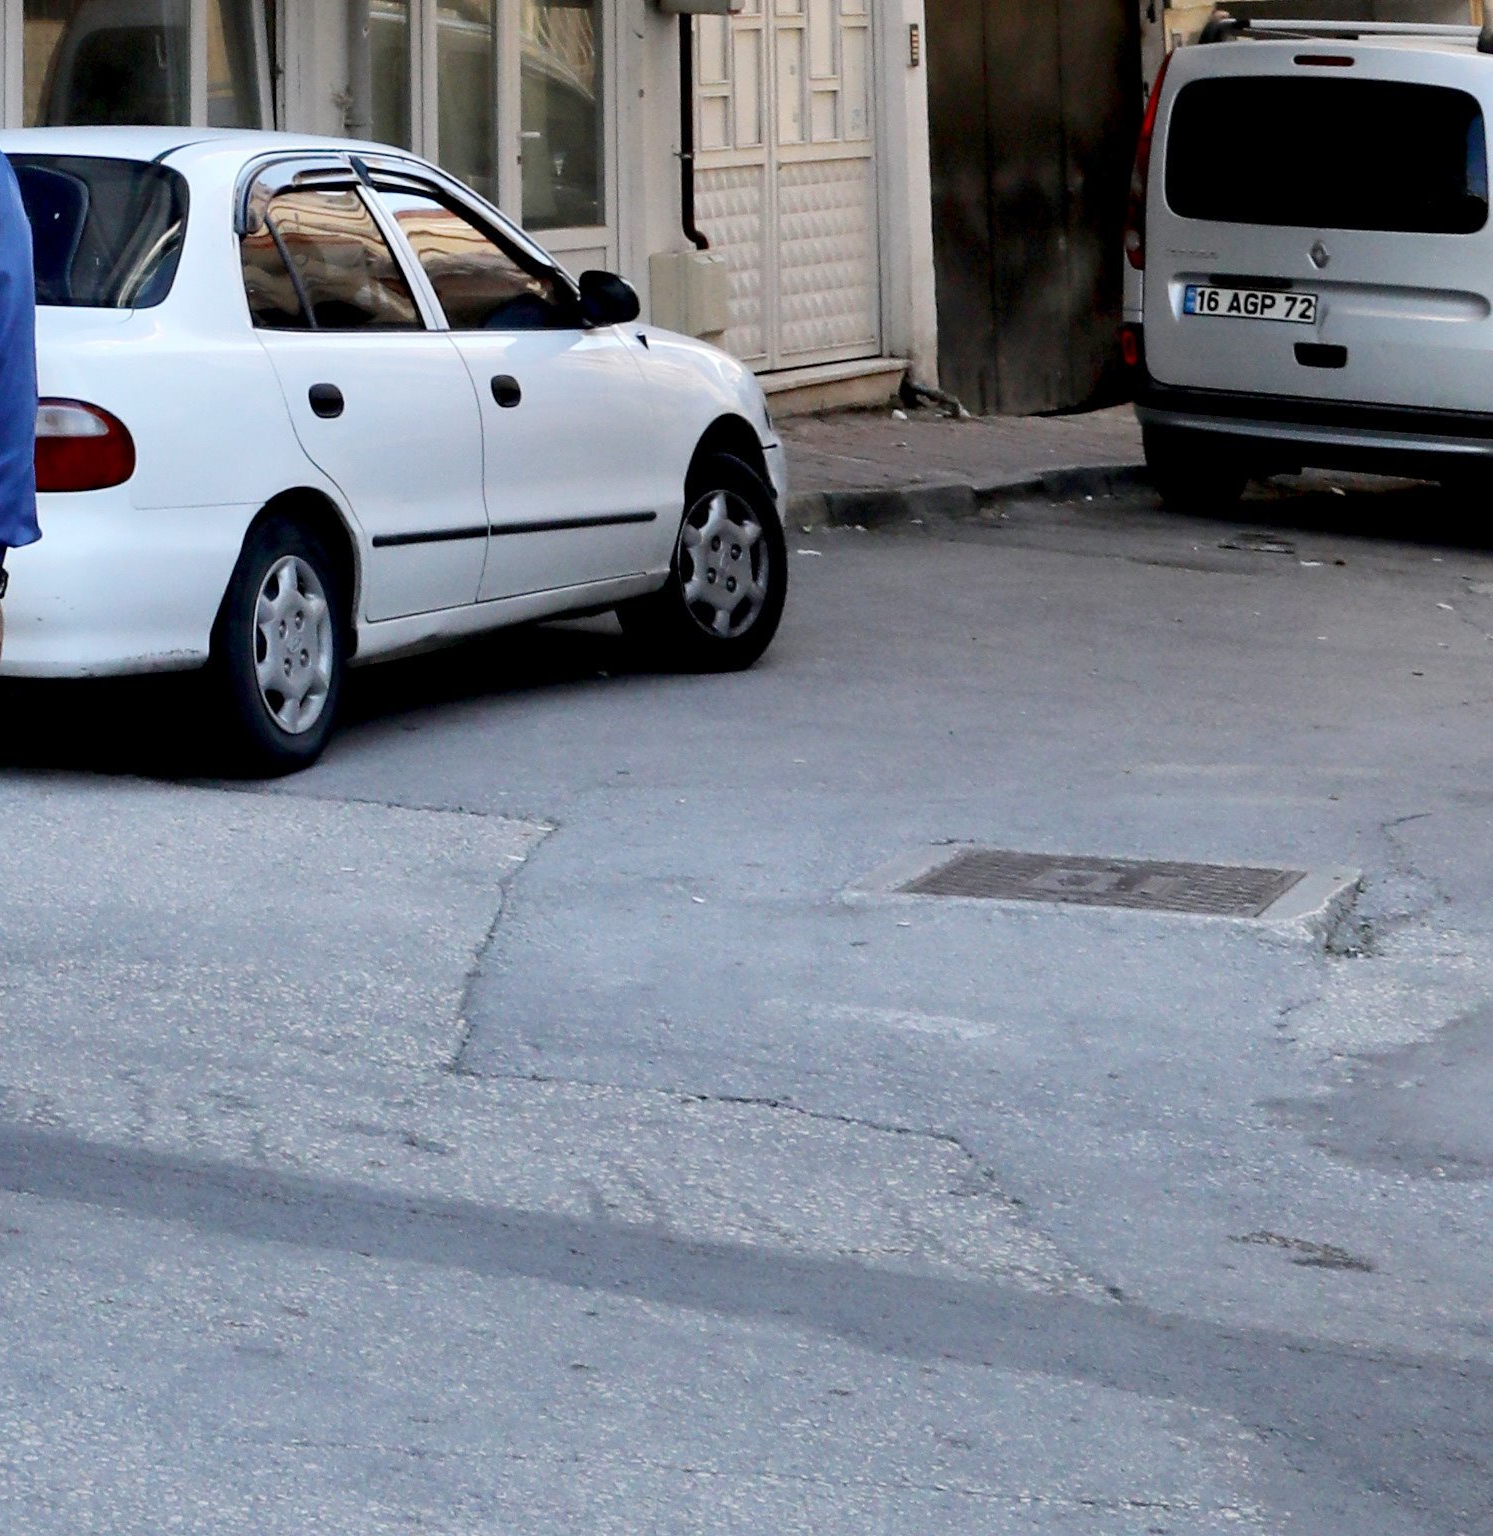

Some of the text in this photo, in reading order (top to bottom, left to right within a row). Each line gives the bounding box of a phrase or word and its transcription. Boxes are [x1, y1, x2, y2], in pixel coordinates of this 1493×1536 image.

[1197, 289, 1314, 320] 16 AGP 72
